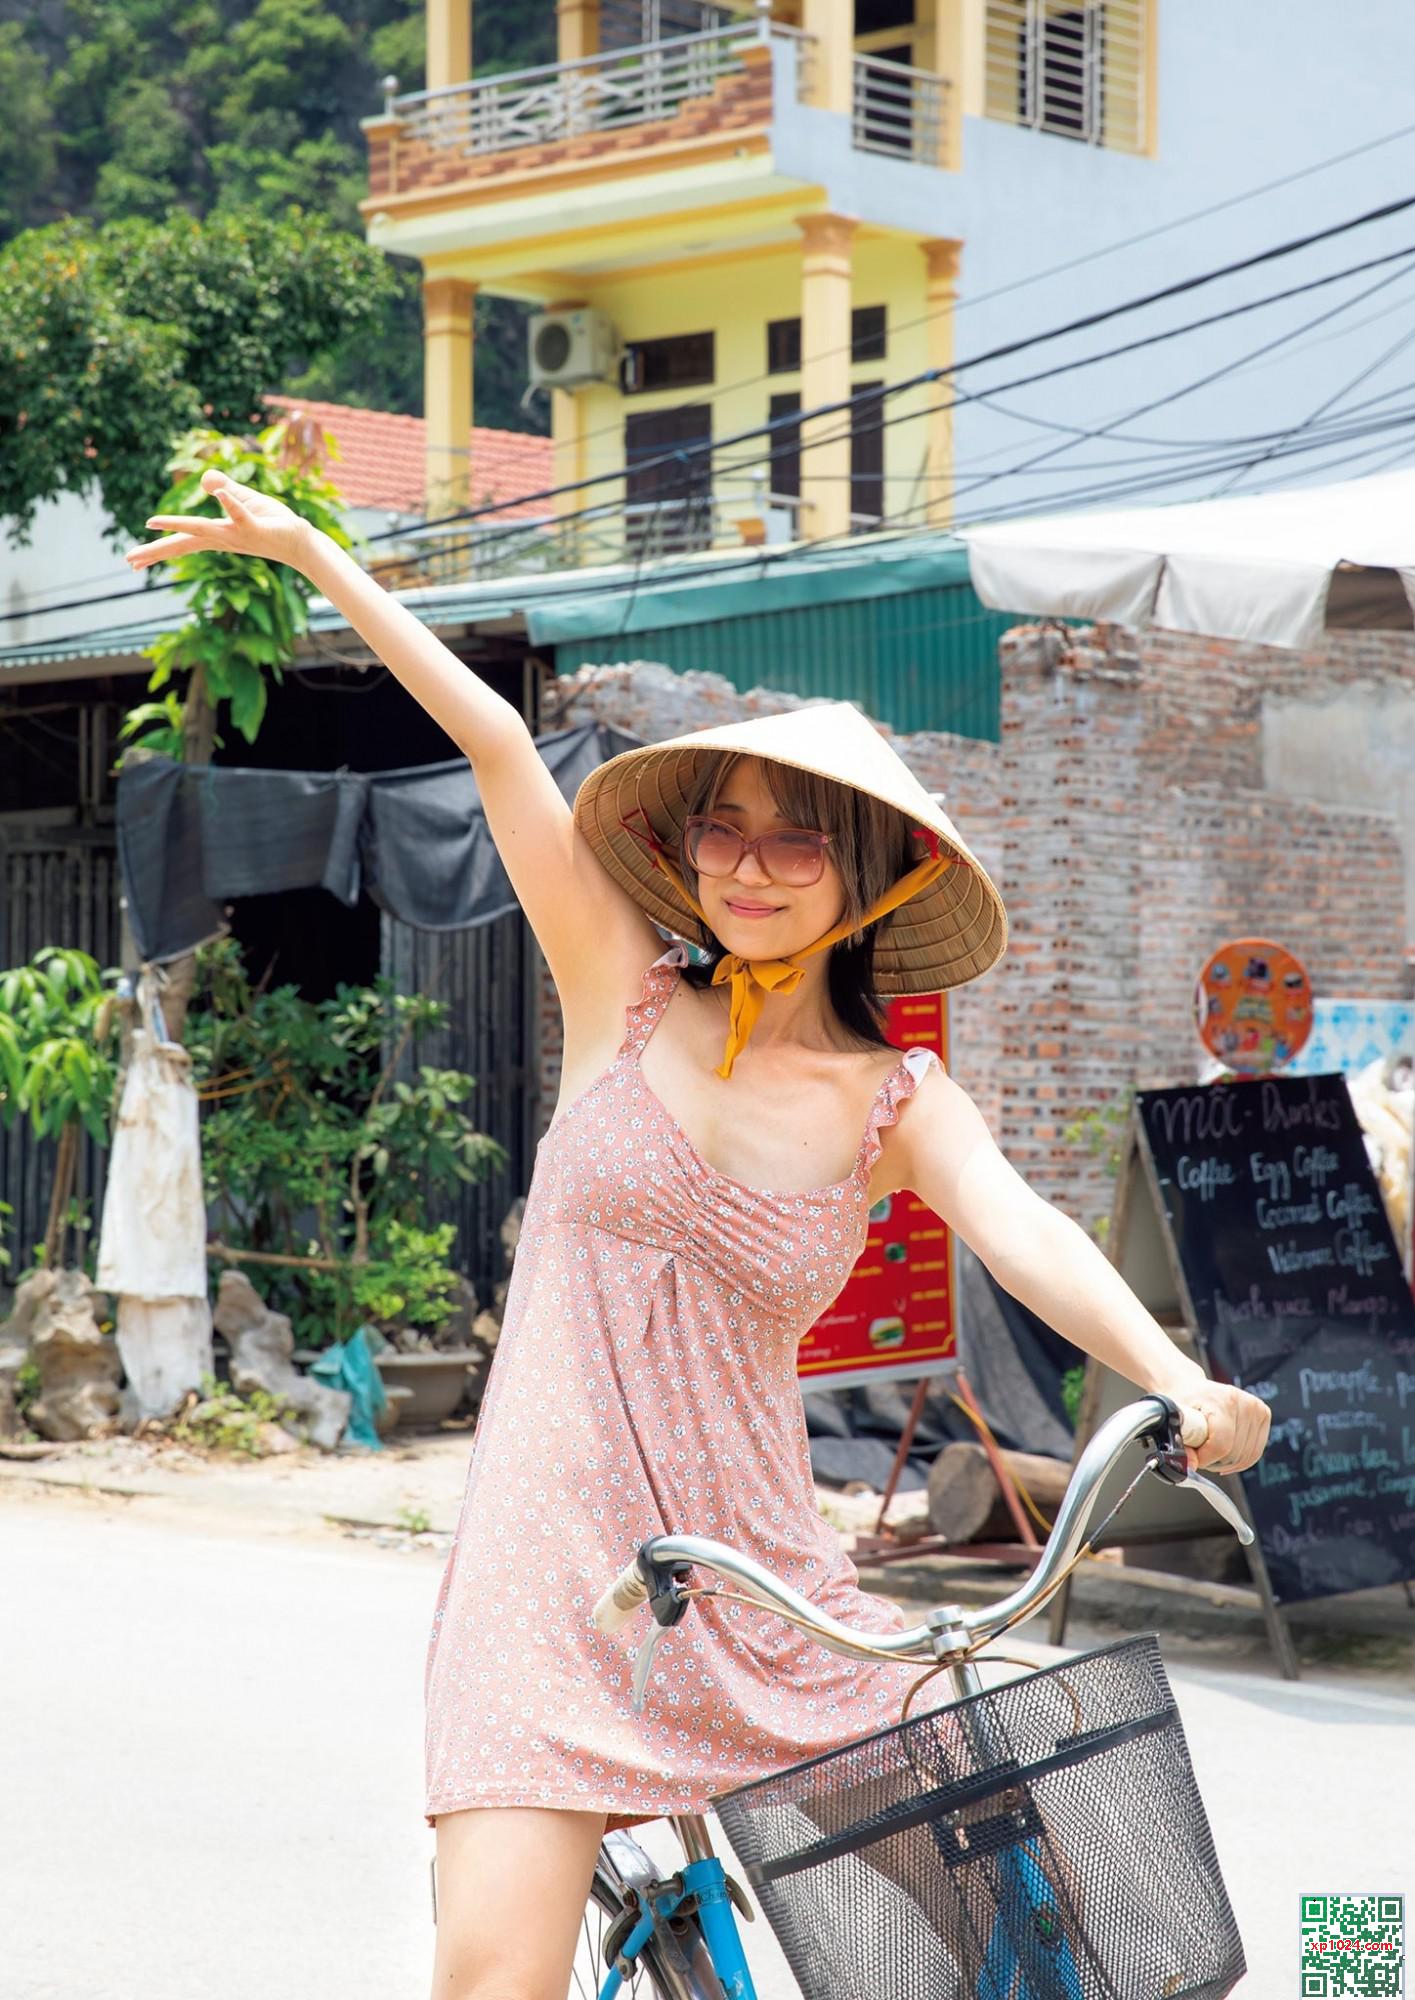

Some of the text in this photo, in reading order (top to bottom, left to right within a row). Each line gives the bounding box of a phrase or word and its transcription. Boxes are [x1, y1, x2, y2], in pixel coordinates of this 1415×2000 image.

[1250, 1151, 1291, 1200] Egg
[1293, 1145, 1341, 1187] Coffee
[1326, 1183, 1379, 1230] Coffee
[1335, 1228, 1391, 1276] Coffee
